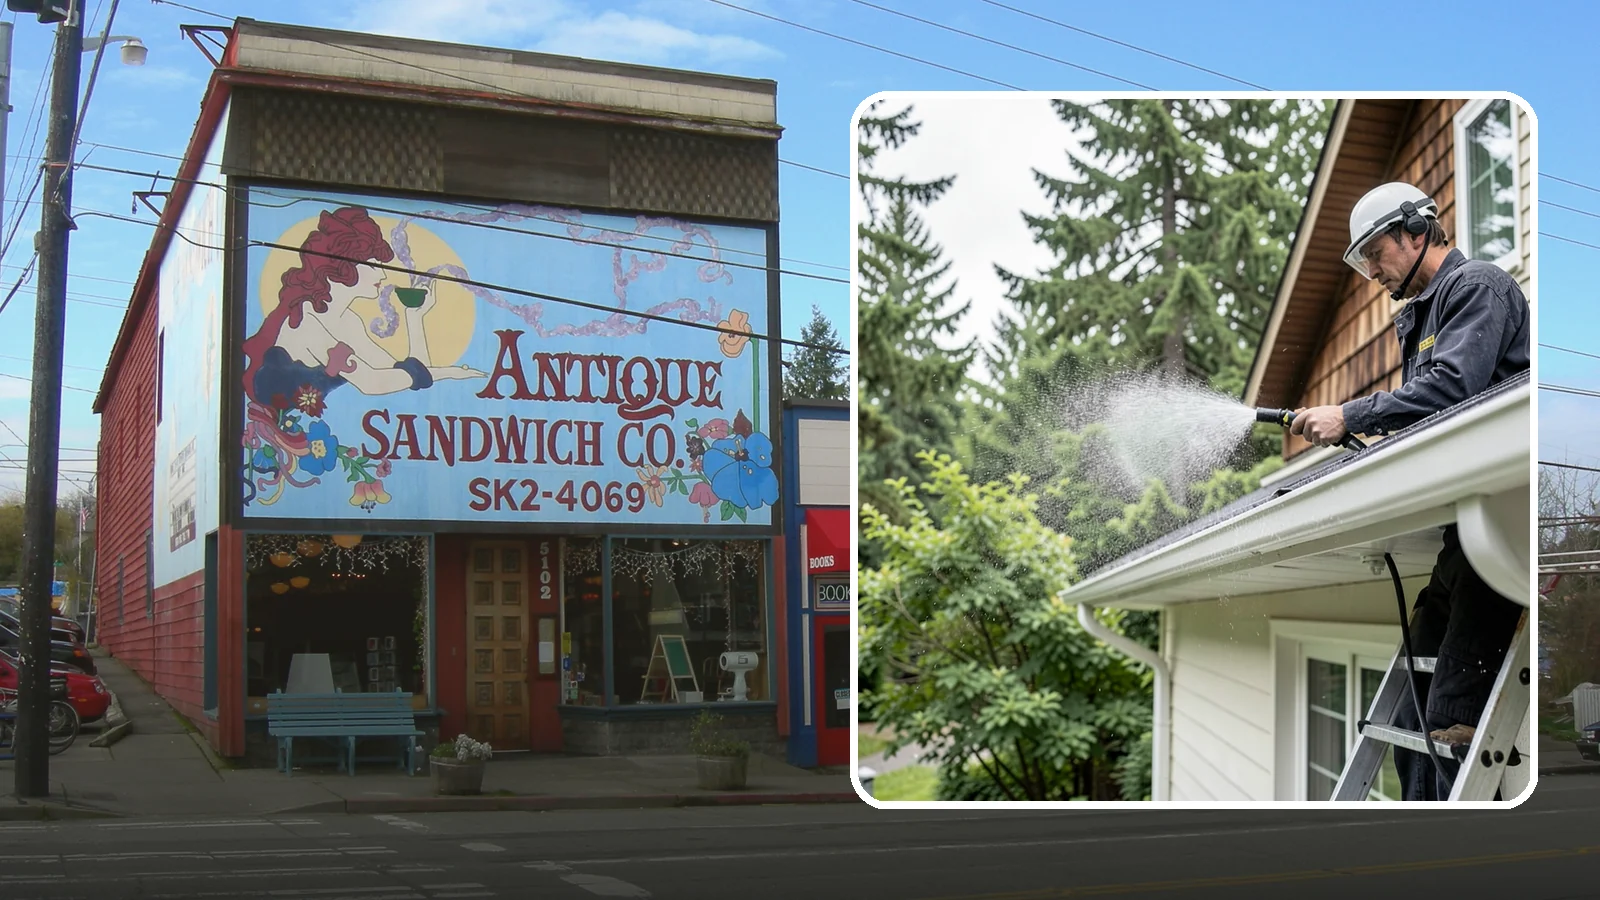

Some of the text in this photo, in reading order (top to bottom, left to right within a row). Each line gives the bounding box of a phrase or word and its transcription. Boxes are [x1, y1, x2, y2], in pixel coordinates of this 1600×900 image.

[475, 329, 723, 421] ANTIQUE
[361, 408, 685, 469] SANDWICH CO.
[468, 477, 646, 513] SK2-4069
[540, 542, 551, 600] 5102
[809, 555, 835, 569] BOOKS
